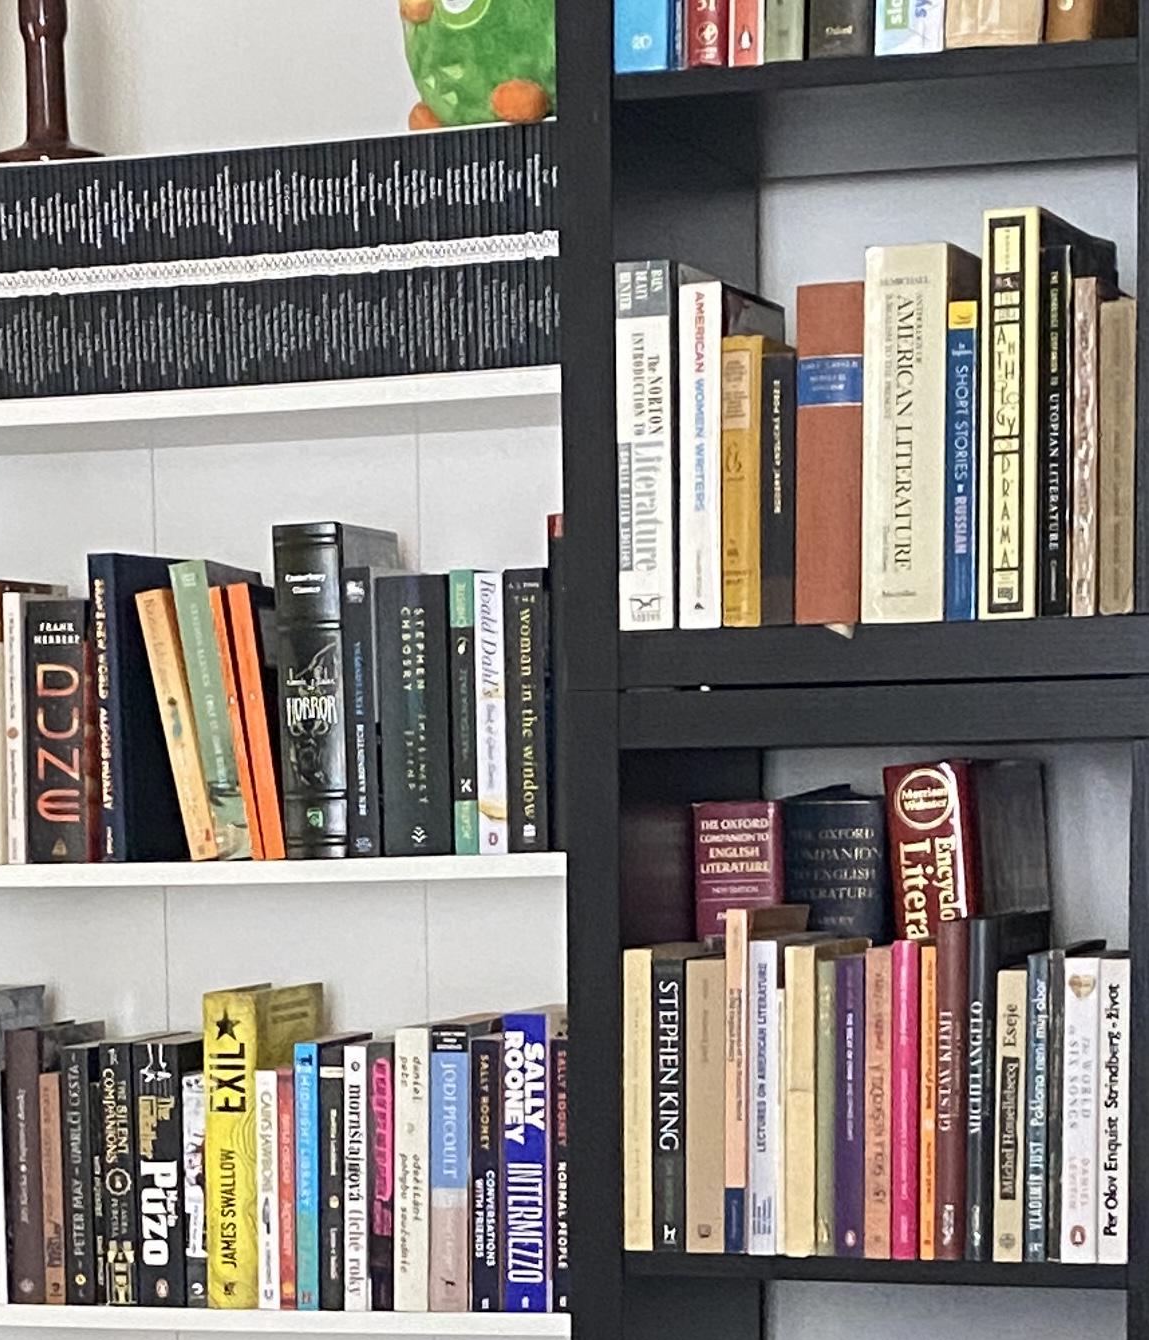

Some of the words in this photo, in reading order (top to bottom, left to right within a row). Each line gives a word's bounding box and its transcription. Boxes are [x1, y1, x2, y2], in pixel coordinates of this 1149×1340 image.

[694, 292, 705, 373] AMERICAN
[895, 294, 915, 417] AMERICAN
[695, 378, 705, 438] WOMEN
[954, 365, 968, 419] SHORT
[694, 443, 705, 511] WRITERS
[954, 421, 968, 481] STORIES
[633, 442, 665, 572] Literature
[894, 424, 914, 572] LITERATURE
[954, 496, 967, 554] RUSSIAN
[997, 453, 1014, 569] DRAMA
[480, 579, 497, 635] Roald
[481, 639, 499, 698] Dahl's
[519, 608, 532, 676] woman
[286, 694, 338, 727] HORROR
[521, 684, 535, 701] in
[37, 663, 80, 822] DUNE
[521, 709, 537, 738] the
[523, 745, 538, 817] window
[700, 861, 770, 874] LITERATURE
[709, 846, 760, 858] ENGLISH
[935, 836, 956, 922] Encyclo
[900, 840, 931, 940] Litera
[757, 962, 768, 1025] LITERATURE
[1103, 983, 1119, 1019] život
[658, 980, 678, 1085] STEPHEN
[757, 1028, 768, 1080] AMERICAN
[938, 1009, 952, 1061] KLIMT
[1002, 1003, 1018, 1048] Eseje
[209, 1043, 246, 1113] EXIL
[441, 1061, 456, 1104] JODI
[480, 1054, 489, 1091] SALLY
[504, 1031, 524, 1144] ROONEY
[525, 1042, 545, 1130] SALLY
[757, 1083, 768, 1098] ON
[969, 1000, 983, 1135] MICHELANGELO
[1103, 1031, 1122, 1108] Strindberg
[103, 1068, 118, 1163] COMPANIONS
[480, 1096, 489, 1150] ROONEY
[558, 1093, 567, 1147] ROONEY
[658, 1091, 679, 1151] KING
[757, 1101, 768, 1153] LECTURES
[938, 1067, 952, 1132] GUSTAV
[443, 1106, 457, 1179] PICOULT
[1001, 1148, 1015, 1194] Michel
[1103, 1116, 1122, 1172] Enquist
[219, 1149, 236, 1217] SWALLOW
[475, 1179, 484, 1208] WITH
[558, 1162, 567, 1217] NORMAL
[1103, 1176, 1118, 1210] Olov
[221, 1222, 237, 1269] JAMES
[475, 1211, 485, 1258] FRIENDS
[486, 1170, 495, 1266] CONVERSATIONS
[507, 1163, 544, 1284] INTERMEZZO
[558, 1223, 567, 1269] PEOPLE
[1103, 1212, 1118, 1237] Per
[347, 1257, 364, 1296] roky
